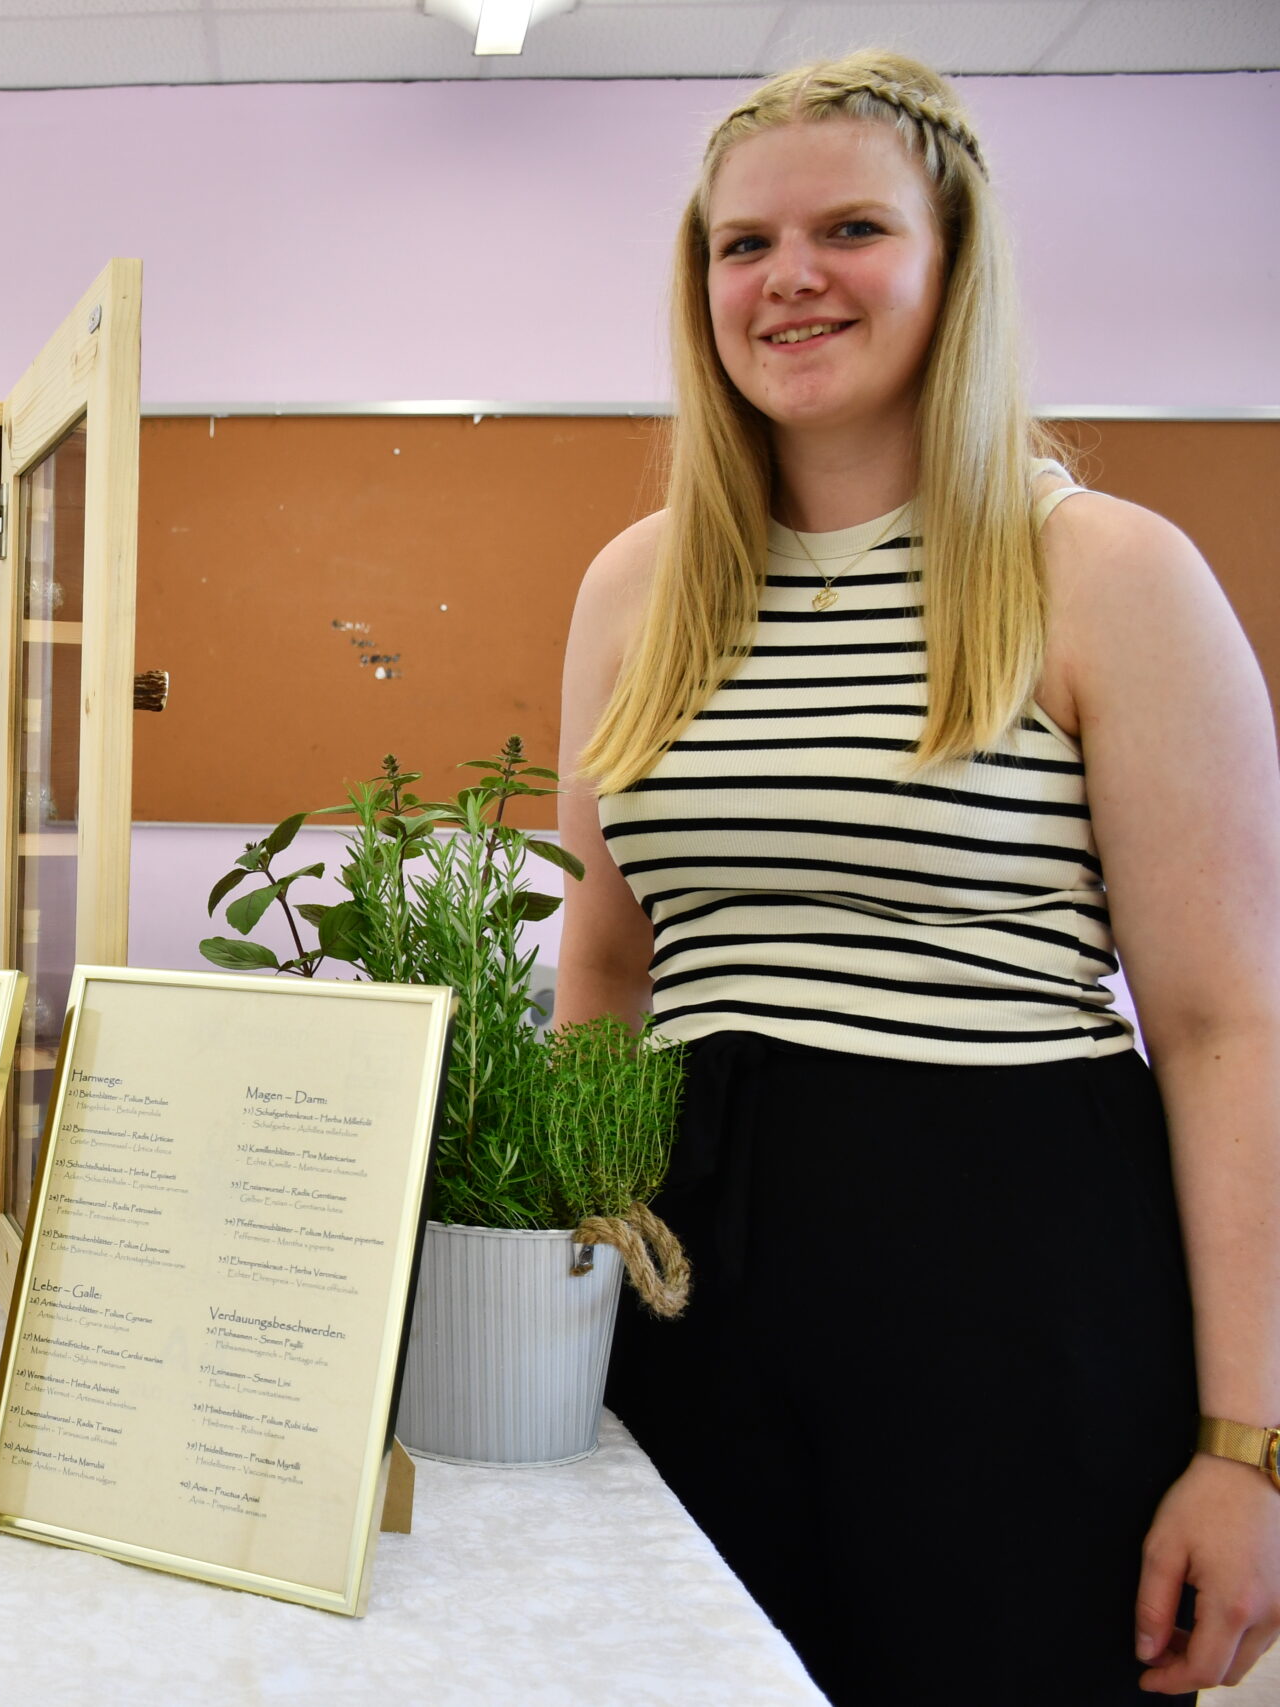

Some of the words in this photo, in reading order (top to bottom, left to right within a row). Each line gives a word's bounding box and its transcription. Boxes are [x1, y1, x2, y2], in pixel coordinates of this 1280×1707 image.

[71, 1068, 123, 1088] Harnwege:
[123, 1094, 144, 1103] Folium
[245, 1086, 283, 1103] Magen
[294, 1090, 328, 1105] Darm:
[320, 1114, 342, 1123] Herba
[302, 1150, 317, 1159] Flos
[129, 1168, 149, 1177] Herba
[291, 1187, 310, 1197] Radix
[299, 1227, 322, 1237] Folium
[119, 1239, 139, 1249] Folium
[289, 1264, 312, 1275] Herba
[32, 1277, 63, 1293] Leber
[72, 1284, 102, 1299] Galle:
[104, 1308, 124, 1319] Folium
[209, 1306, 346, 1340] Verdauungsbeschwerden:
[96, 1345, 120, 1356] Fructus
[70, 1378, 91, 1389] Herba
[76, 1418, 94, 1428] Radix
[261, 1414, 283, 1426] Folium
[14, 1443, 52, 1458] Andornkraut
[57, 1452, 78, 1464] Herba
[198, 1442, 243, 1459] Heidelbeeren
[250, 1453, 276, 1466] Fructus
[191, 1482, 208, 1492] Anis
[214, 1486, 240, 1499] Fructus
